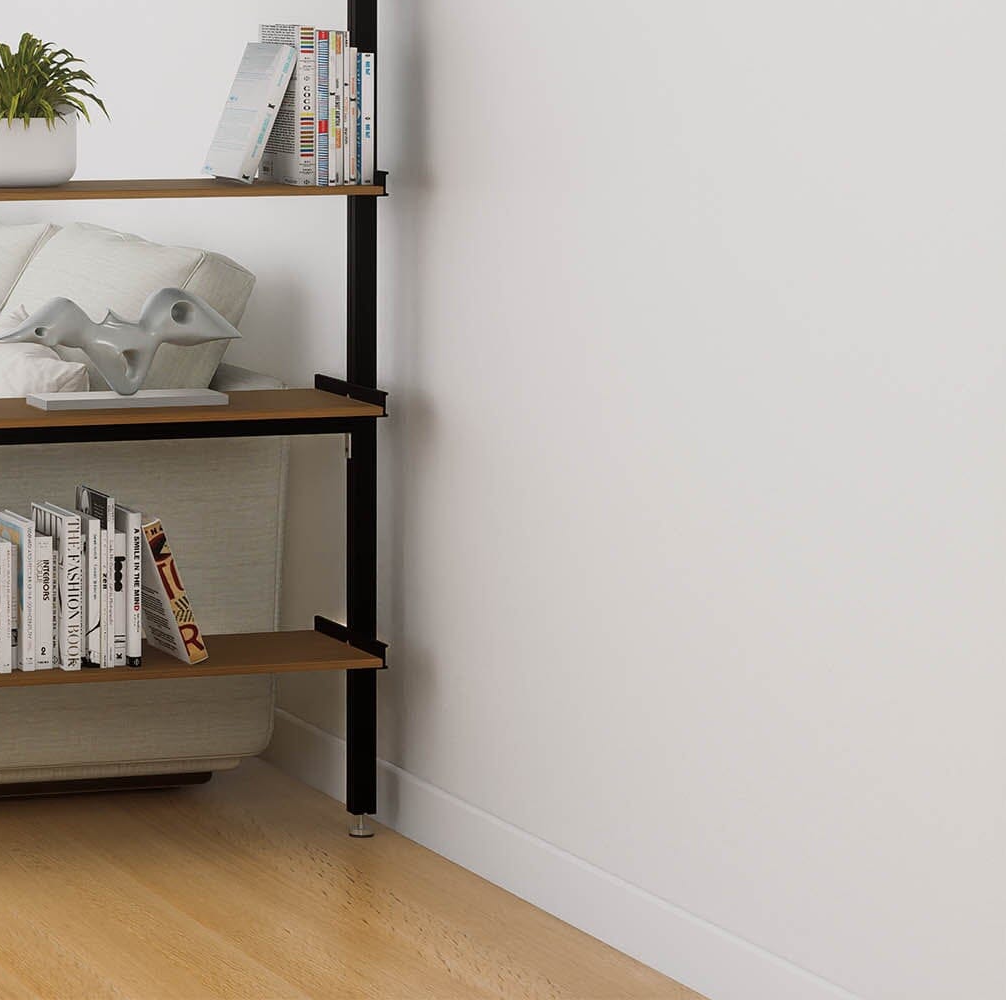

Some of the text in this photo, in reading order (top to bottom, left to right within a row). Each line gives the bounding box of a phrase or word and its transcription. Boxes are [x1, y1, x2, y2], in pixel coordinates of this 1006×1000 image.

[133, 562, 140, 571] IN
[67, 518, 80, 667] THE FASHION BOOK
[41, 646, 46, 655] 2
